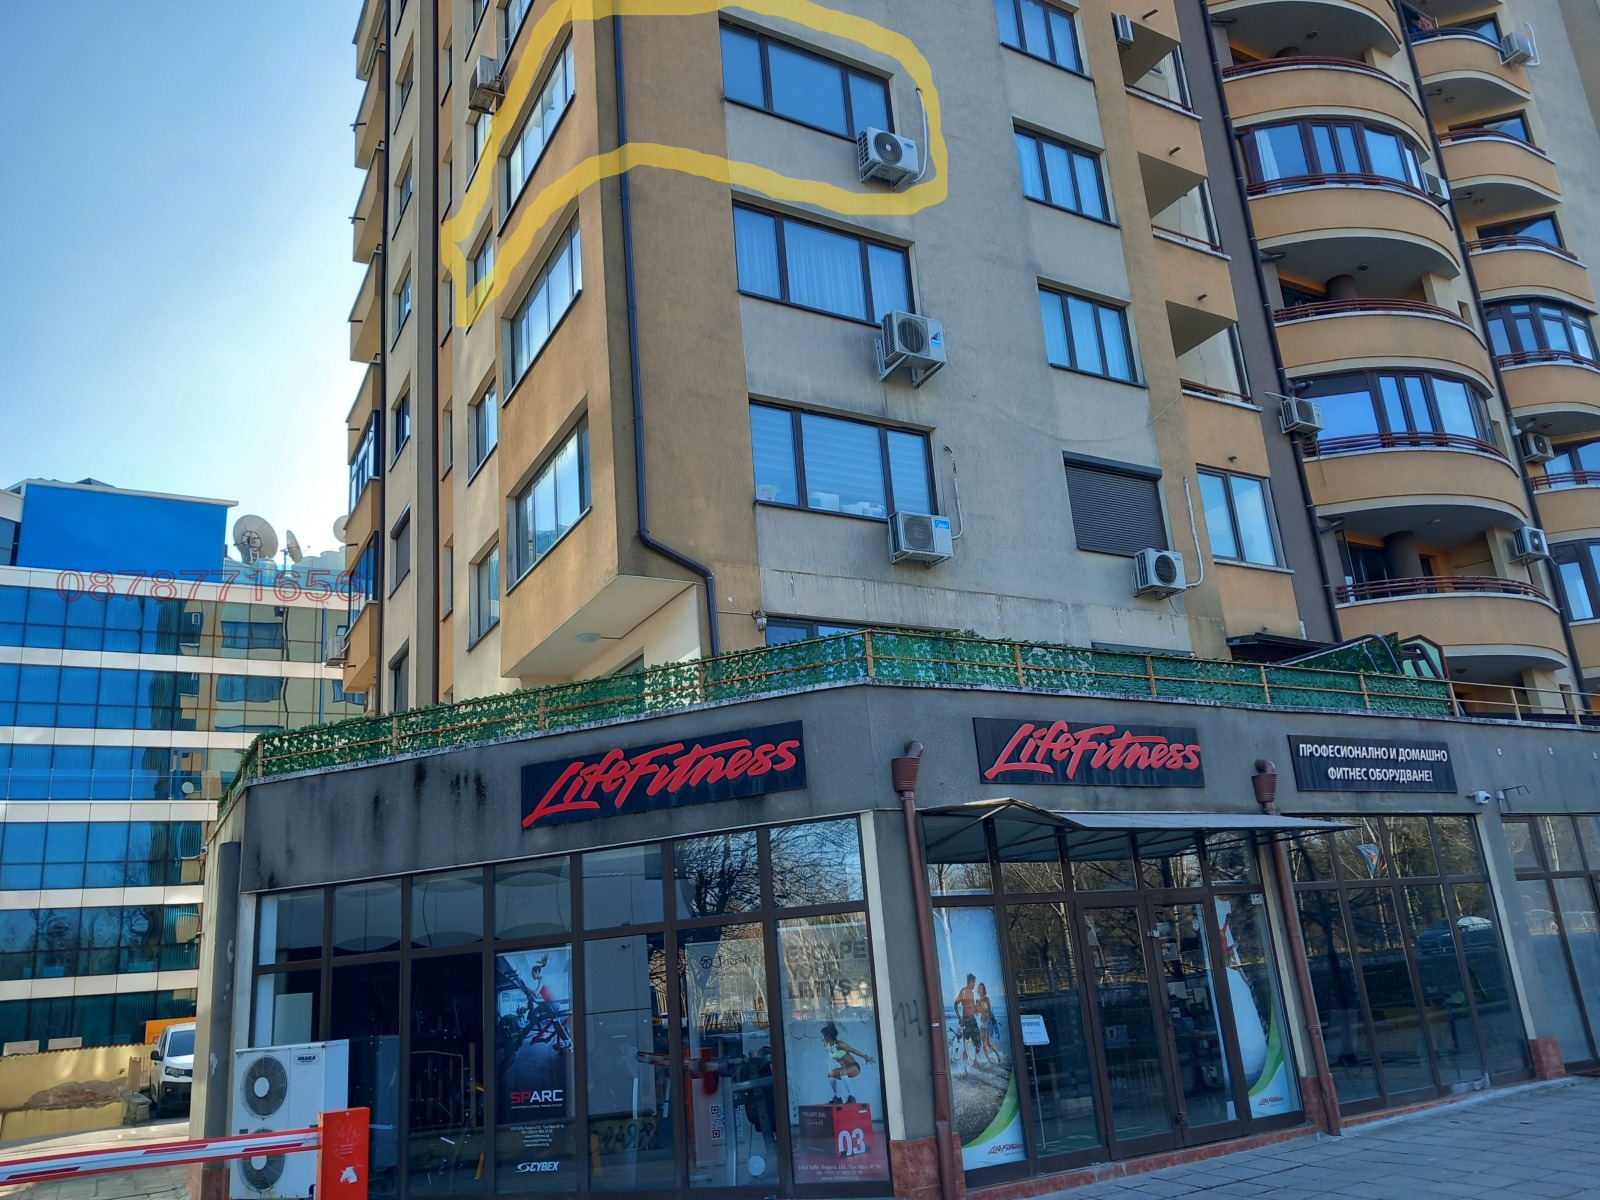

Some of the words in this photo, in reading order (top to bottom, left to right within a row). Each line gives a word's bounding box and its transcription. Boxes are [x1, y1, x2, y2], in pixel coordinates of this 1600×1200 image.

[1299, 743, 1389, 760] ПРОФЕСИОНАЛНО
[1389, 748, 1397, 760] И
[1398, 749, 1448, 762] ДОМАШНО
[1327, 766, 1368, 781] ФИТНЕС
[1368, 767, 1433, 784] ОБОРУДВАНЕ!
[510, 1089, 564, 1104] SPARC
[837, 1127, 866, 1157] 03
[529, 1161, 561, 1172] CYBEX
